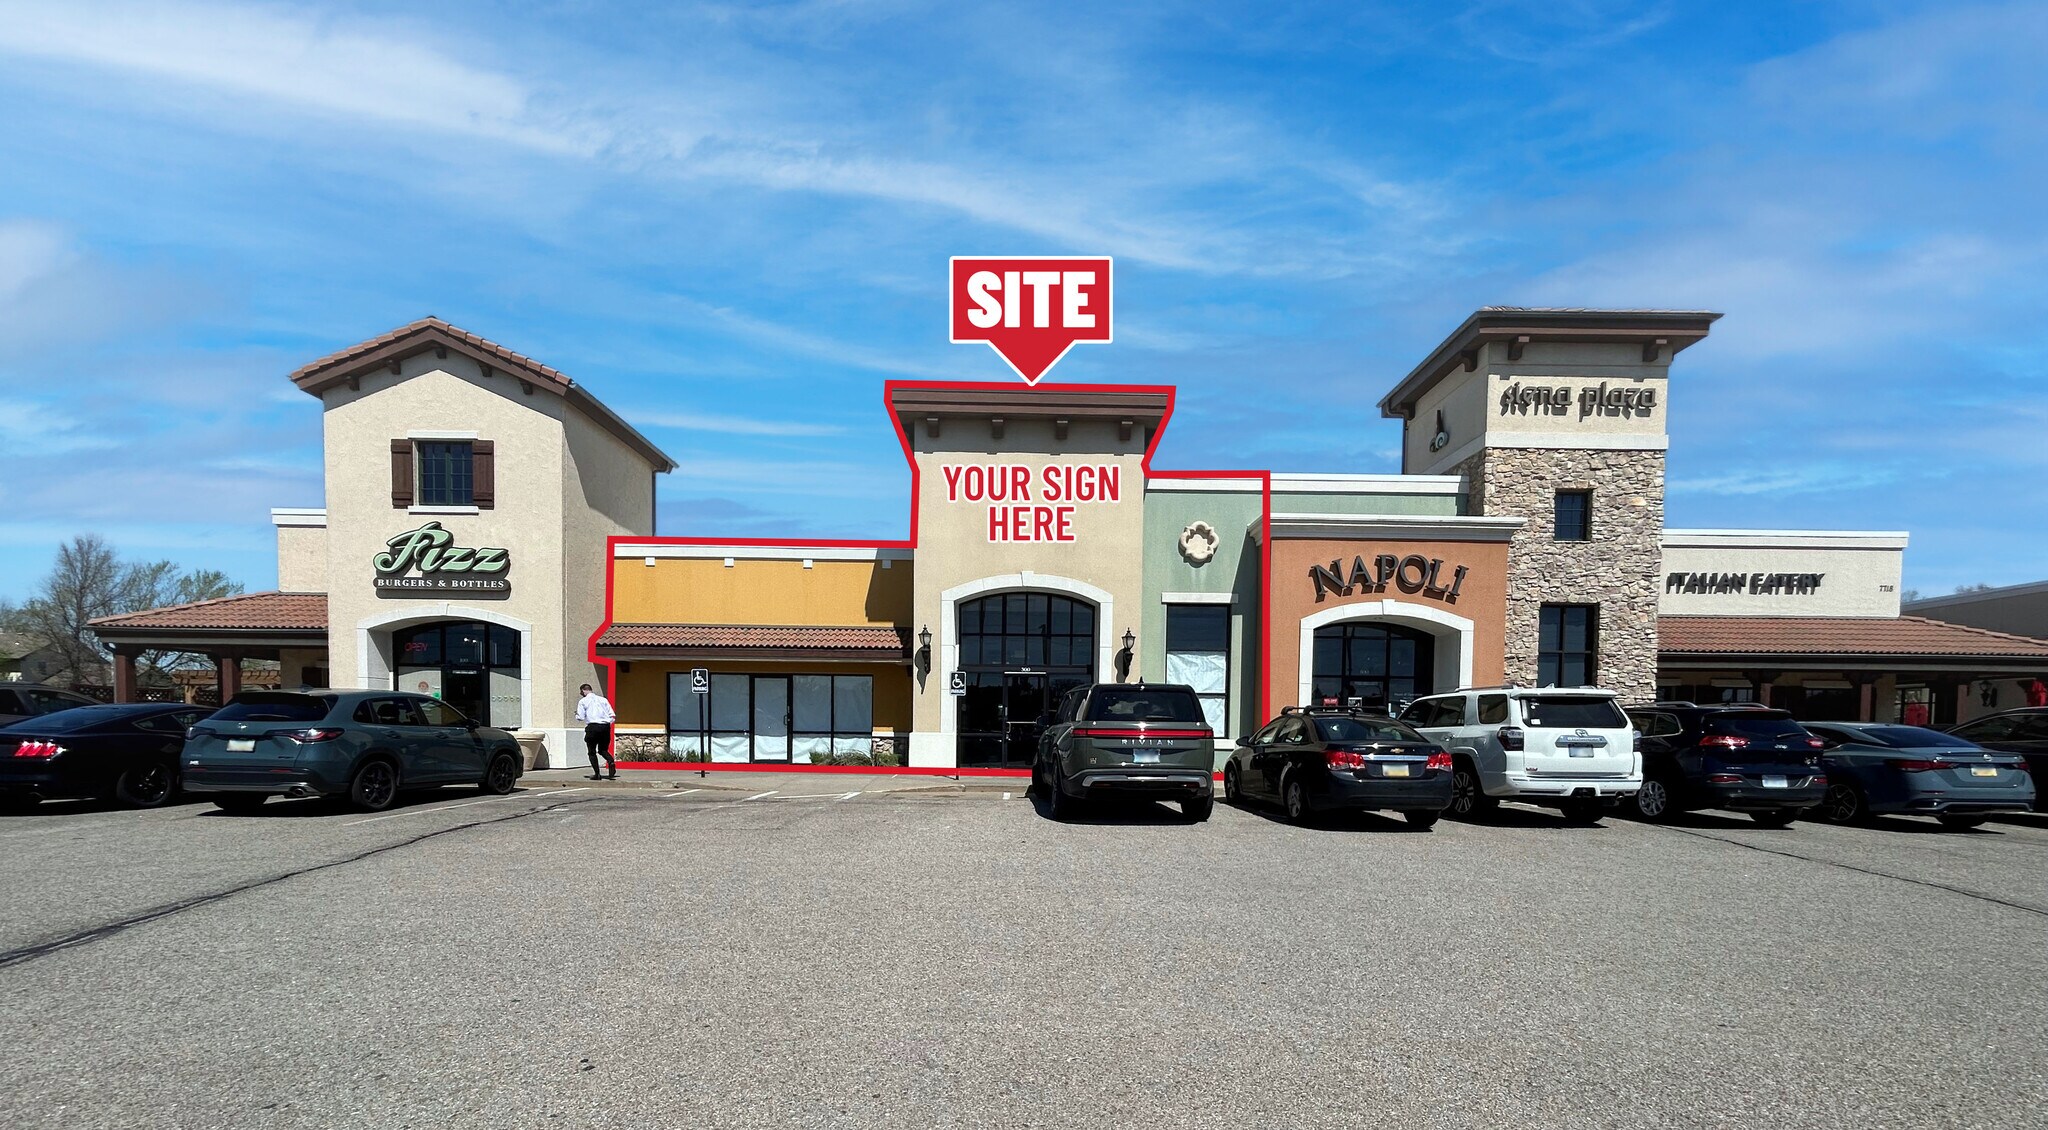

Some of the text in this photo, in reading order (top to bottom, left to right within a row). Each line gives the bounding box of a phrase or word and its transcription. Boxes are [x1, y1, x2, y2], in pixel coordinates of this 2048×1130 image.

[1501, 381, 1657, 412] siena plaza
[377, 578, 505, 589] BURGERS & BOTTLES
[1309, 553, 1469, 598] NAPOLI
[1667, 572, 1825, 591] ITALIAN EATERY
[404, 642, 428, 652] OPEN
